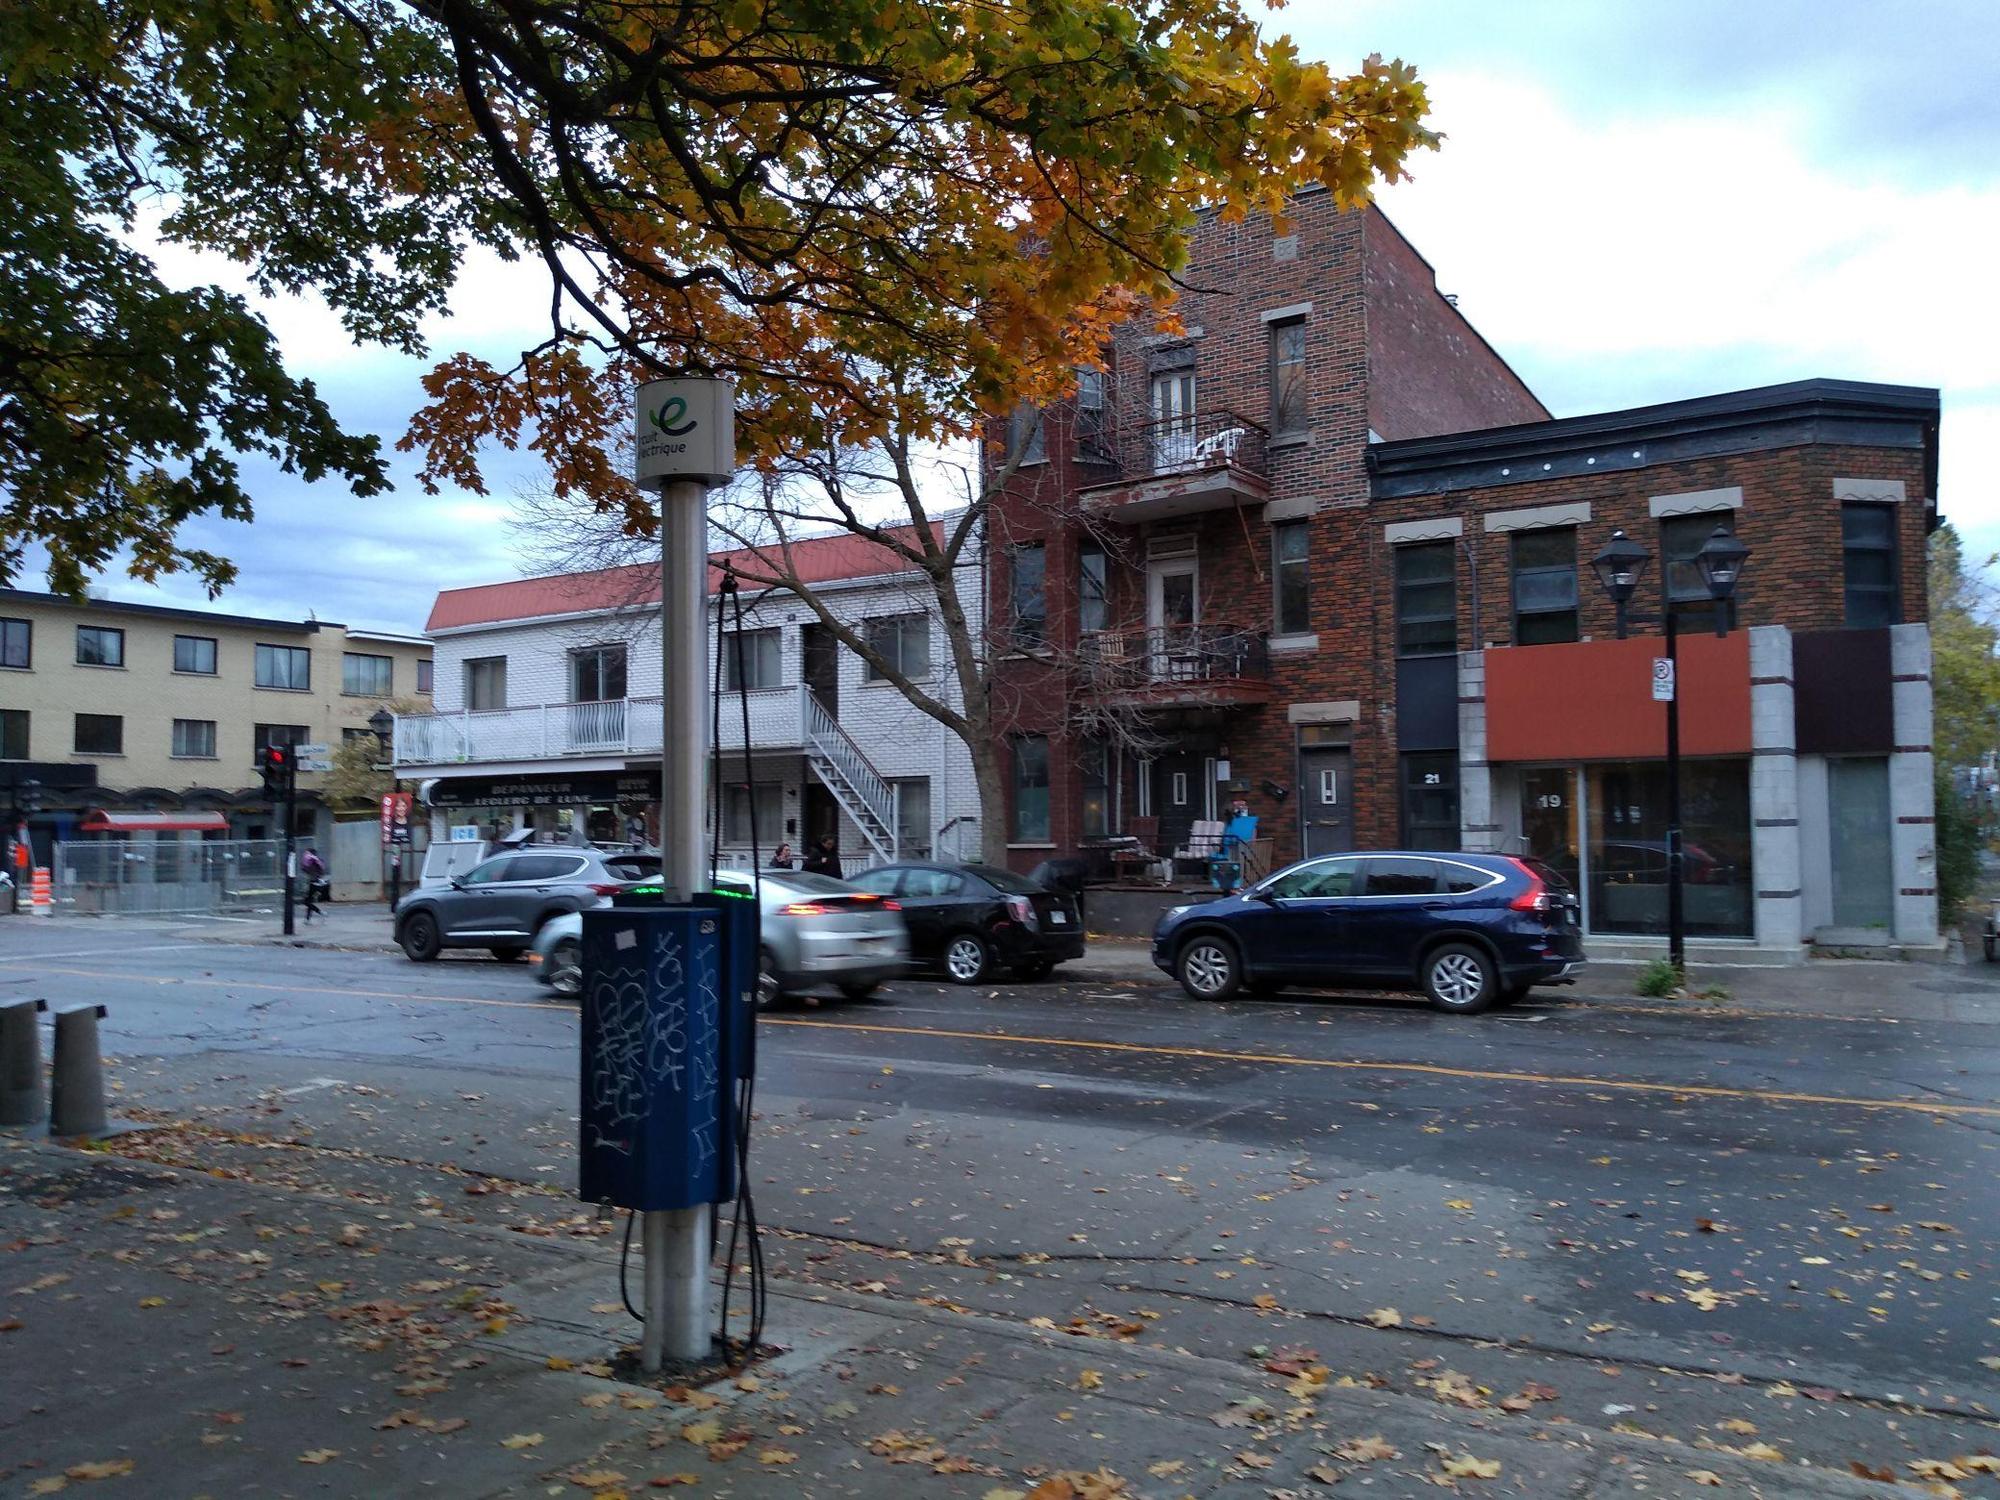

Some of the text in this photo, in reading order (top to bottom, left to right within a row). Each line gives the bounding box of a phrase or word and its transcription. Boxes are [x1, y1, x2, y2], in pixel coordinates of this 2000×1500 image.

[1424, 773, 1440, 784] 21
[534, 796, 552, 804] DE
[1538, 795, 1562, 808] 19
